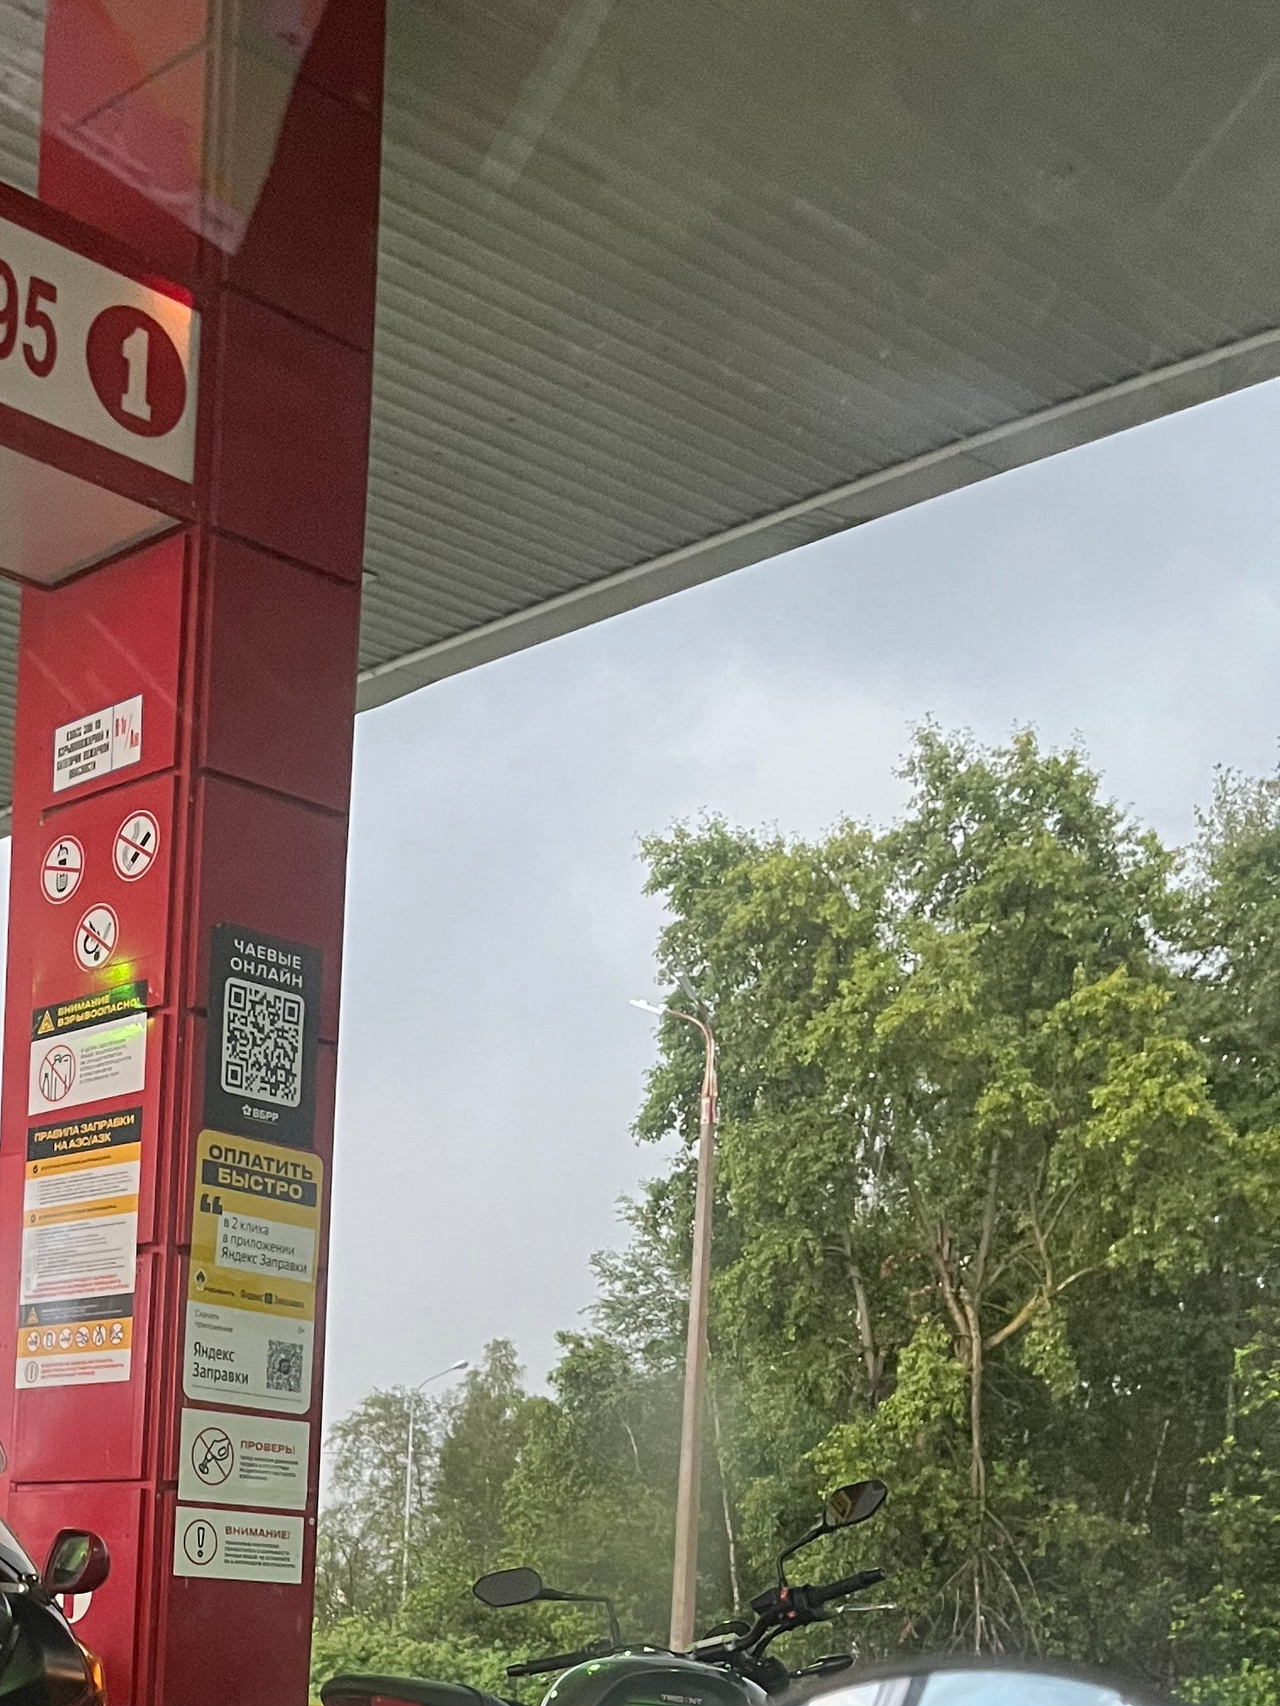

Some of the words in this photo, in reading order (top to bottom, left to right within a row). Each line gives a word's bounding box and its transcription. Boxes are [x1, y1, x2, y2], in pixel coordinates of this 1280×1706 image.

[120, 327, 152, 422] 1
[233, 938, 302, 970] ЧАЕВЫЕ
[230, 956, 303, 988] ОНЛАЙН
[57, 994, 111, 1016] ВНИМАНИЕ
[253, 1110, 279, 1122] ВБРР
[34, 1125, 79, 1143] ПРАВИЛА
[80, 1114, 135, 1134] ЗАПРАВКИ
[53, 1139, 68, 1152] НА
[208, 1143, 313, 1181] ОПЛАТИТЬ
[218, 1167, 303, 1200] БЫСТРО
[223, 1218, 230, 1229] в
[231, 1216, 239, 1230] 2
[239, 1221, 270, 1236] клика
[222, 1233, 229, 1243] в
[230, 1236, 296, 1256] приложении
[221, 1247, 259, 1266] Яндекс
[259, 1250, 308, 1274] Заправки
[193, 1341, 236, 1363] Яндекс
[192, 1361, 249, 1385] Заправки
[240, 1440, 296, 1455] ПРОВЕРЬ!
[225, 1525, 291, 1540] ВНИМАНИЕ!
